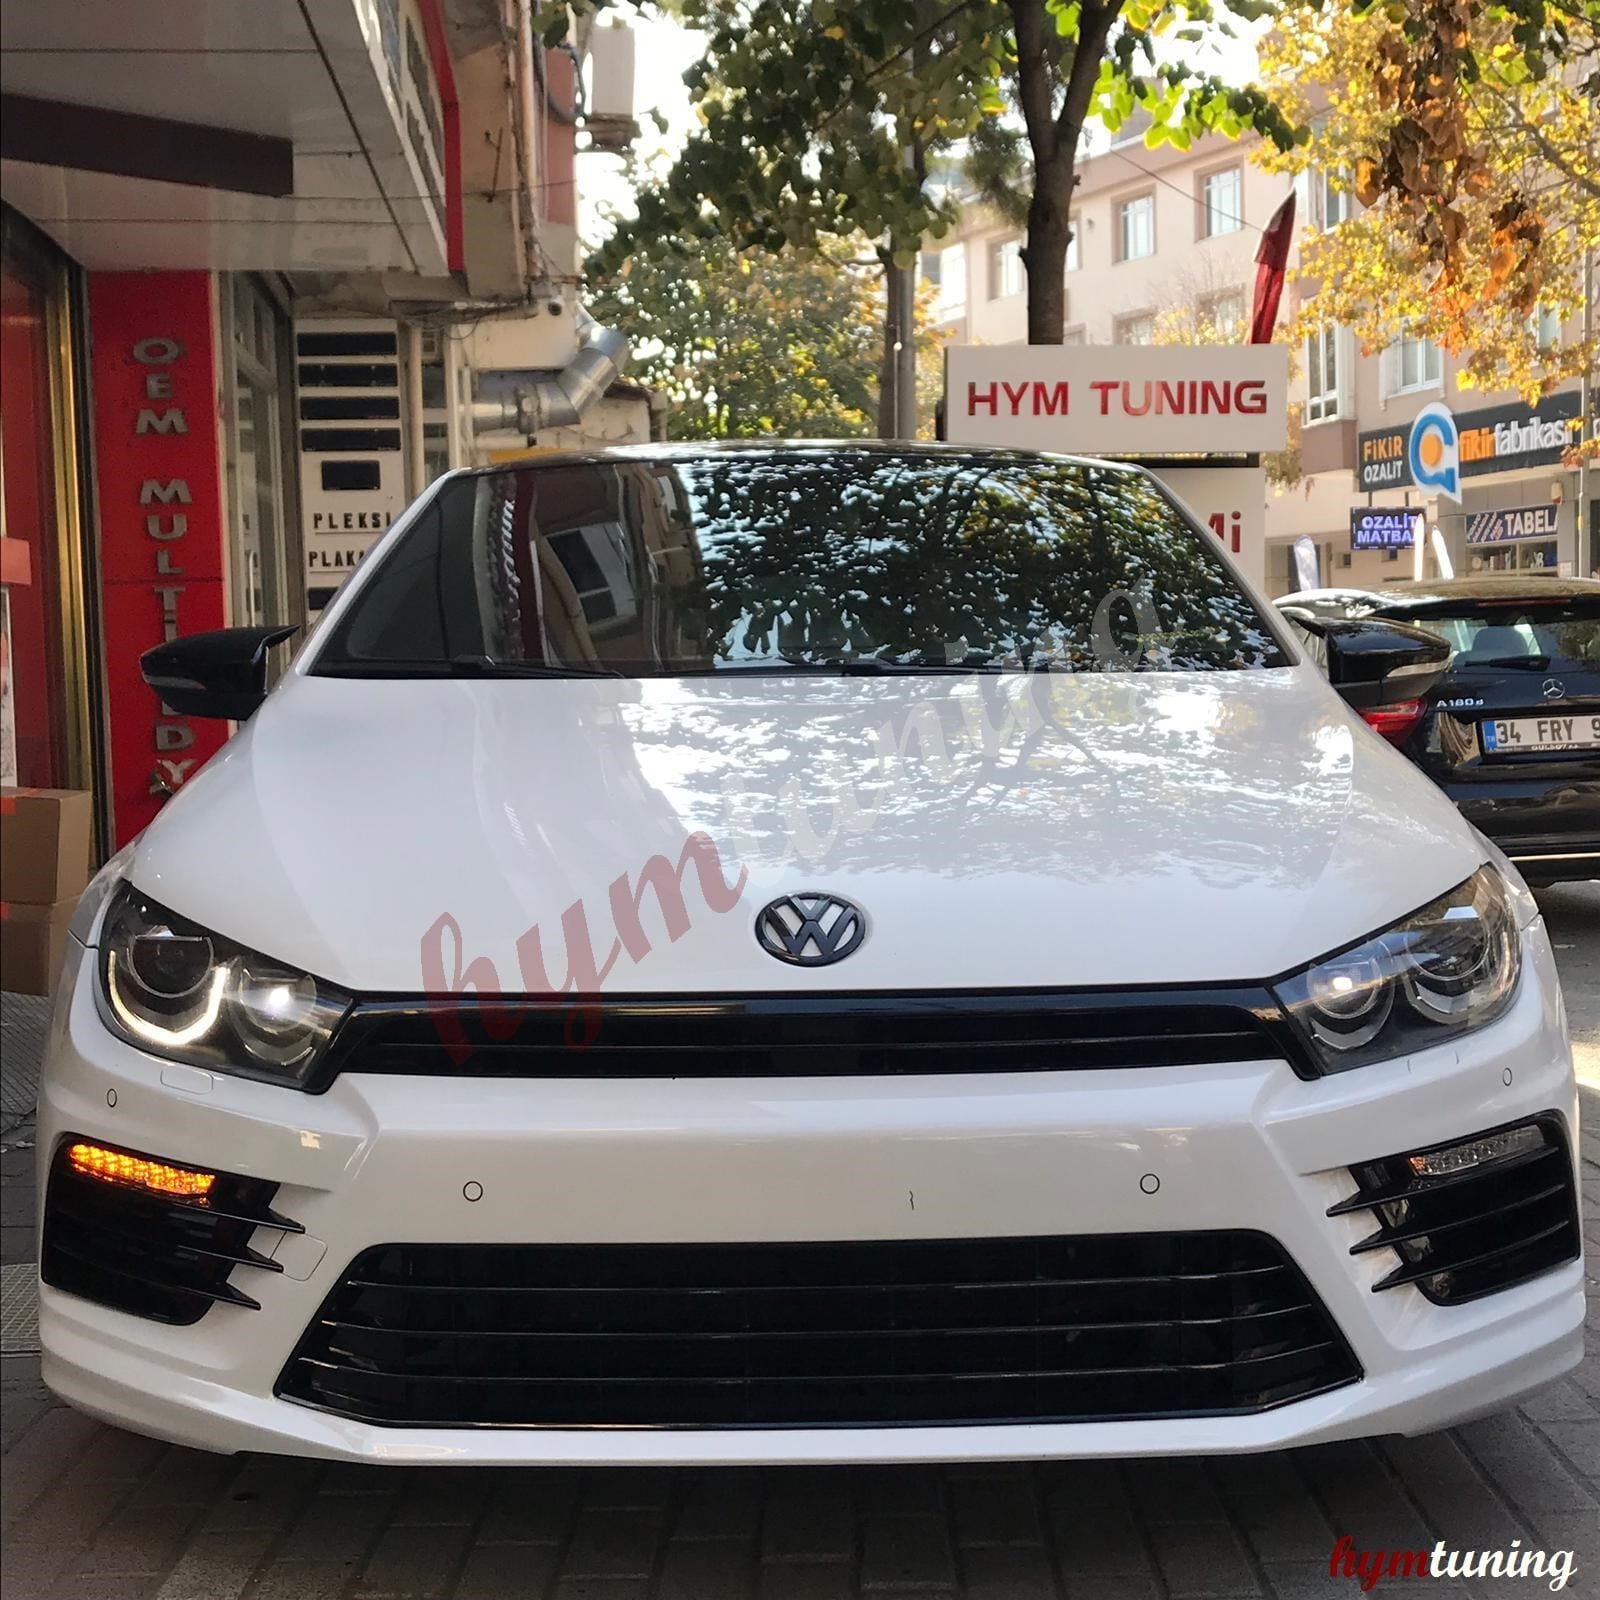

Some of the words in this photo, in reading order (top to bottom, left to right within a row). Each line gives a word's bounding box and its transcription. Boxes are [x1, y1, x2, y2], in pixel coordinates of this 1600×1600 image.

[133, 336, 188, 434] OEM
[967, 381, 1069, 416] HYM
[1089, 380, 1267, 415] TUNING
[1357, 529, 1414, 544] MATBA
[1496, 722, 1522, 744] 34
[1537, 718, 1574, 742] FRY
